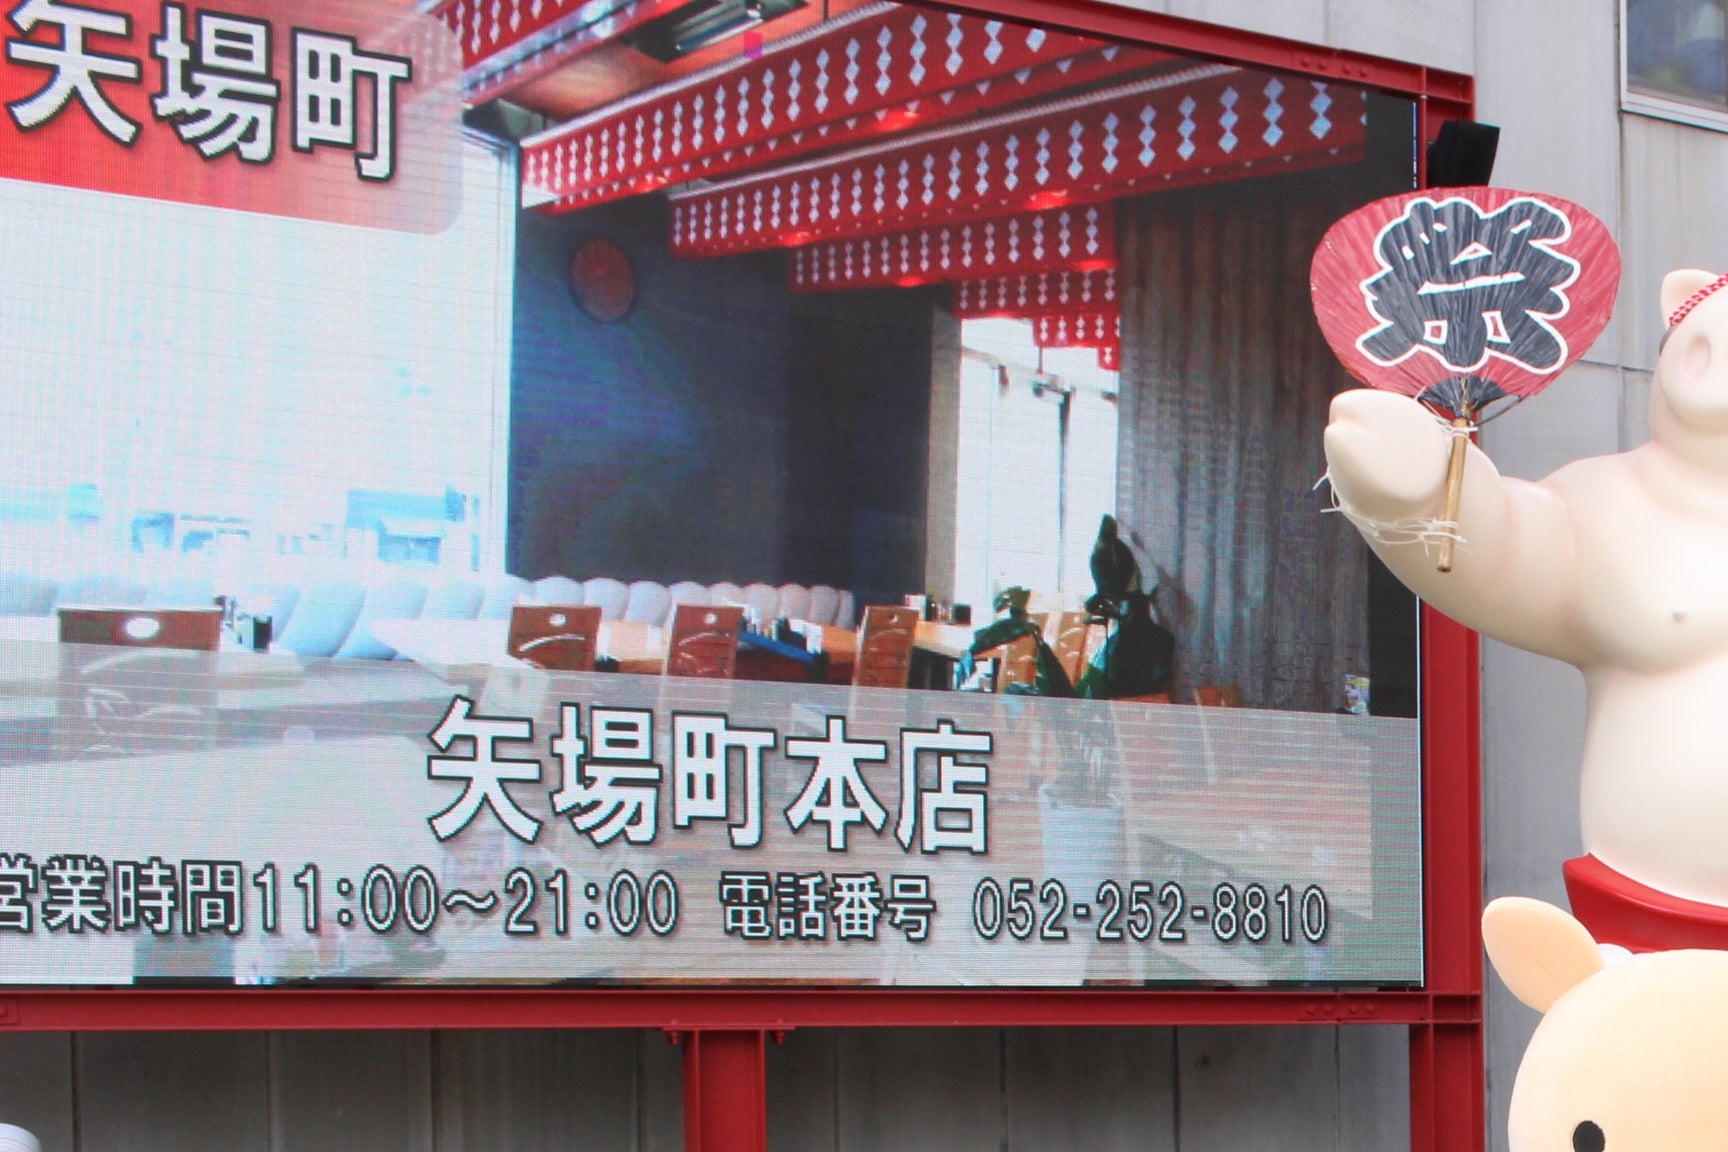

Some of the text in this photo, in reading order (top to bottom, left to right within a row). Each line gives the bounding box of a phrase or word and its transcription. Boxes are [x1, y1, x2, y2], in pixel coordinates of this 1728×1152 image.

[5, 0, 413, 181] 矢場町
[1355, 196, 1581, 375] 祭
[427, 695, 993, 855] 矢場町本店
[720, 870, 937, 943] 電話番号
[973, 877, 1330, 944] 052-252-8810
